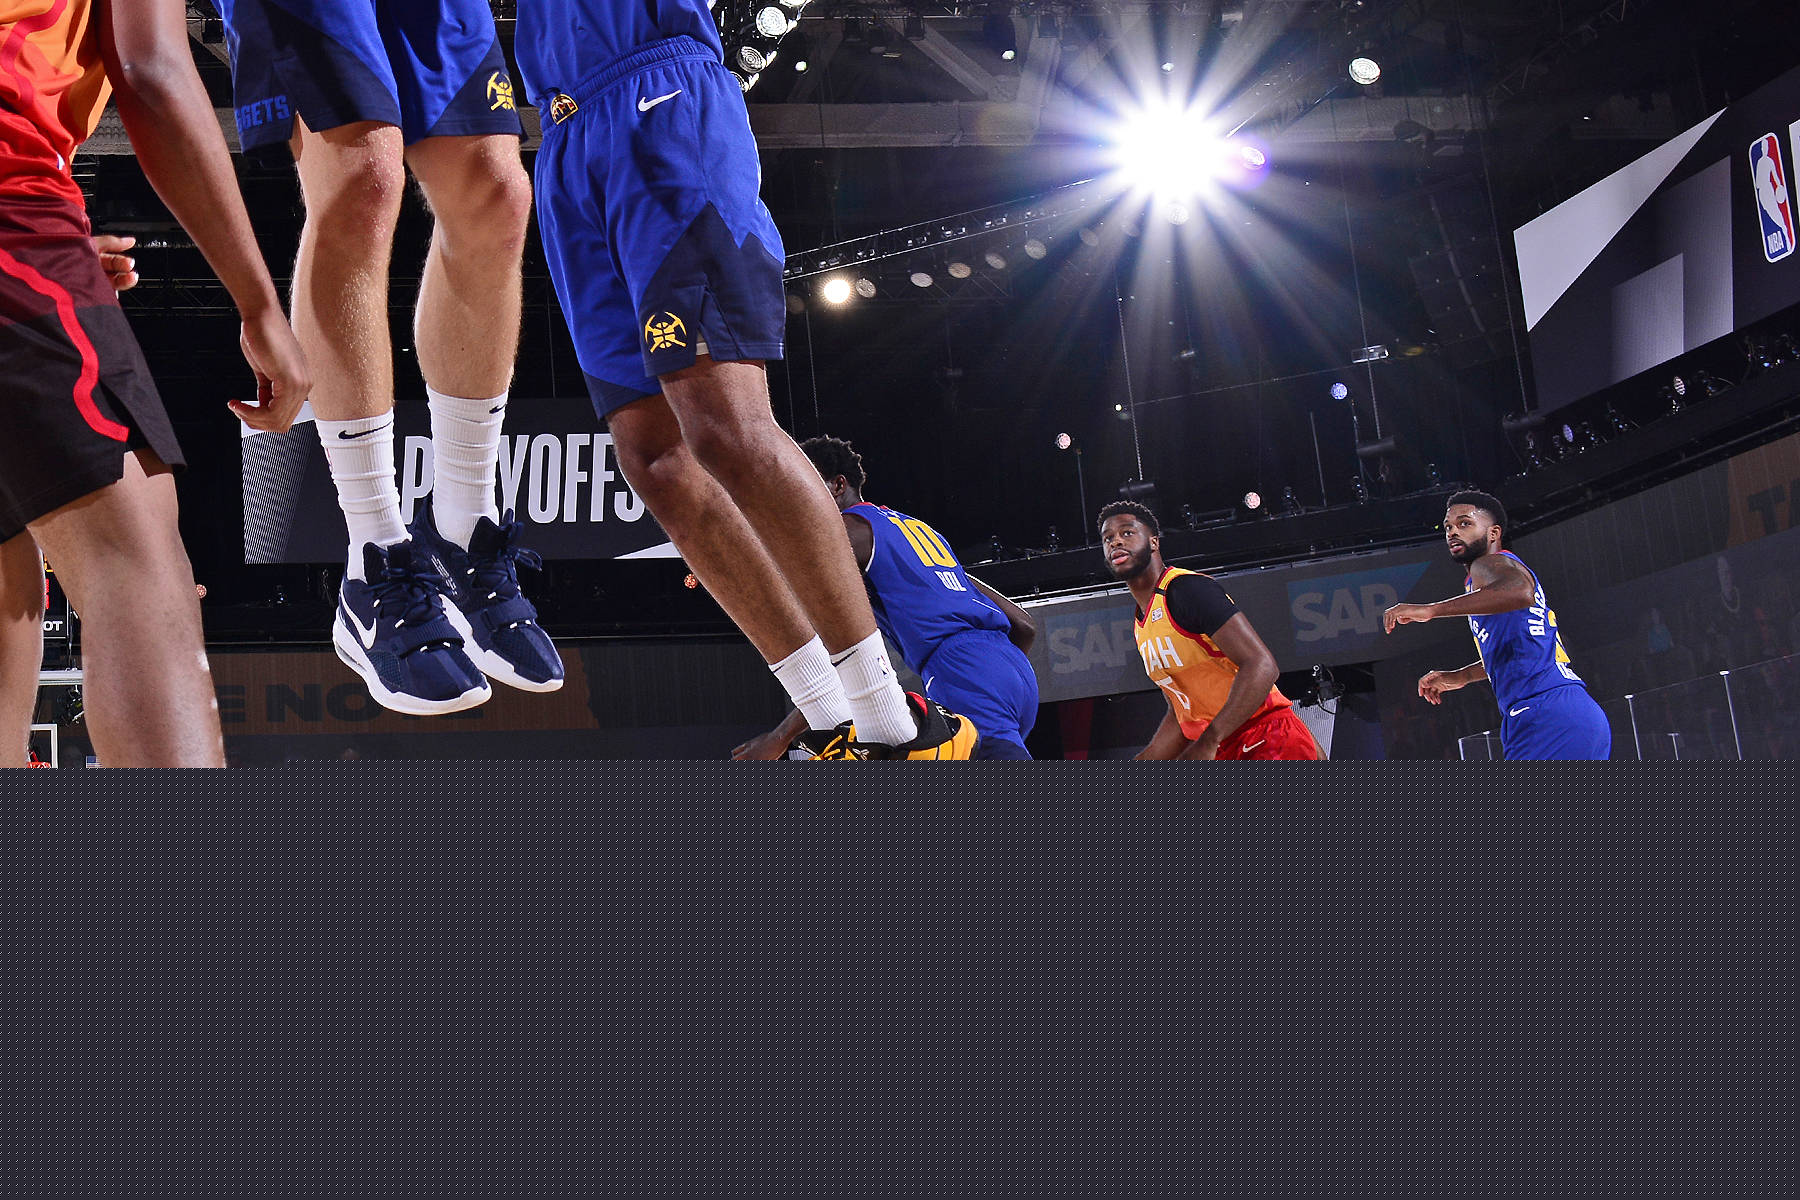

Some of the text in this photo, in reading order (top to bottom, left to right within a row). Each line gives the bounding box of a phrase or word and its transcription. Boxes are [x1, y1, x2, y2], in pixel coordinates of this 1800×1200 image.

[1767, 230, 1785, 254] NBA
[400, 433, 645, 525] PYOFF
[887, 516, 958, 568] 10
[934, 570, 968, 592] BOL
[1292, 583, 1399, 642] SAP
[1140, 636, 1184, 676] TAH
